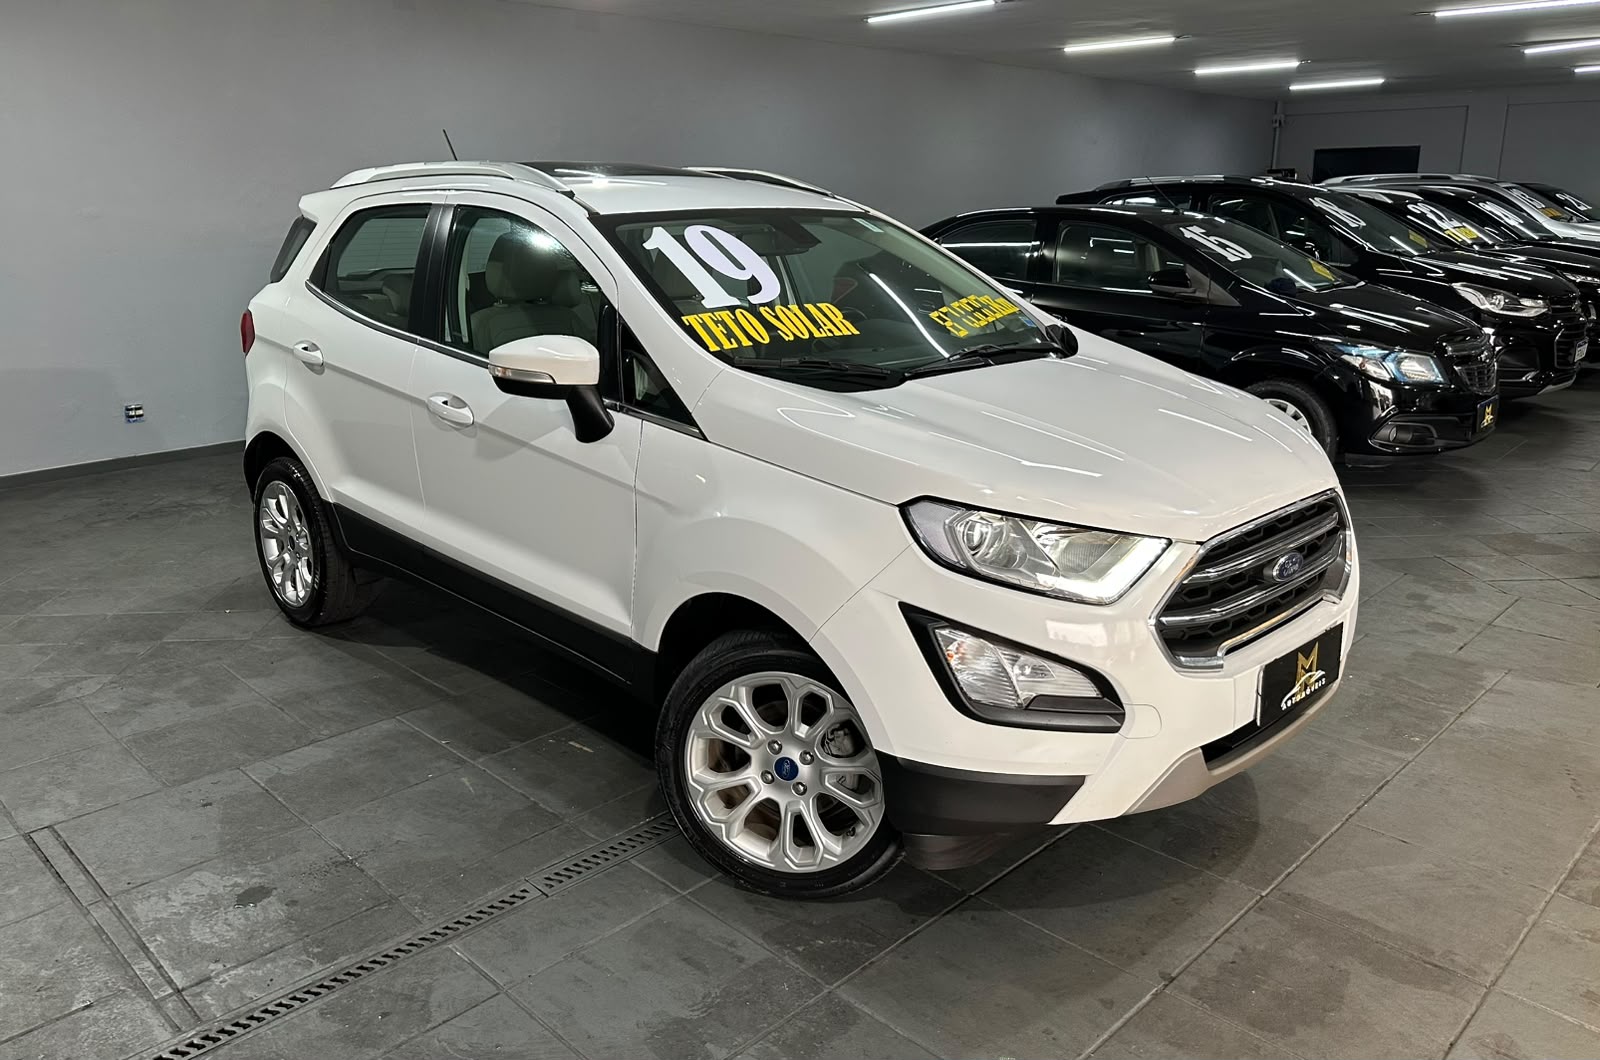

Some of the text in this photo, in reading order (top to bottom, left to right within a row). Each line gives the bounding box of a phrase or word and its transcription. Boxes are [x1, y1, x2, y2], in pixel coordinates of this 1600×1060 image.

[1308, 196, 1367, 228] 18
[1179, 225, 1253, 262] 15
[642, 224, 781, 309] 19
[681, 302, 861, 352] TETO SOLAR
